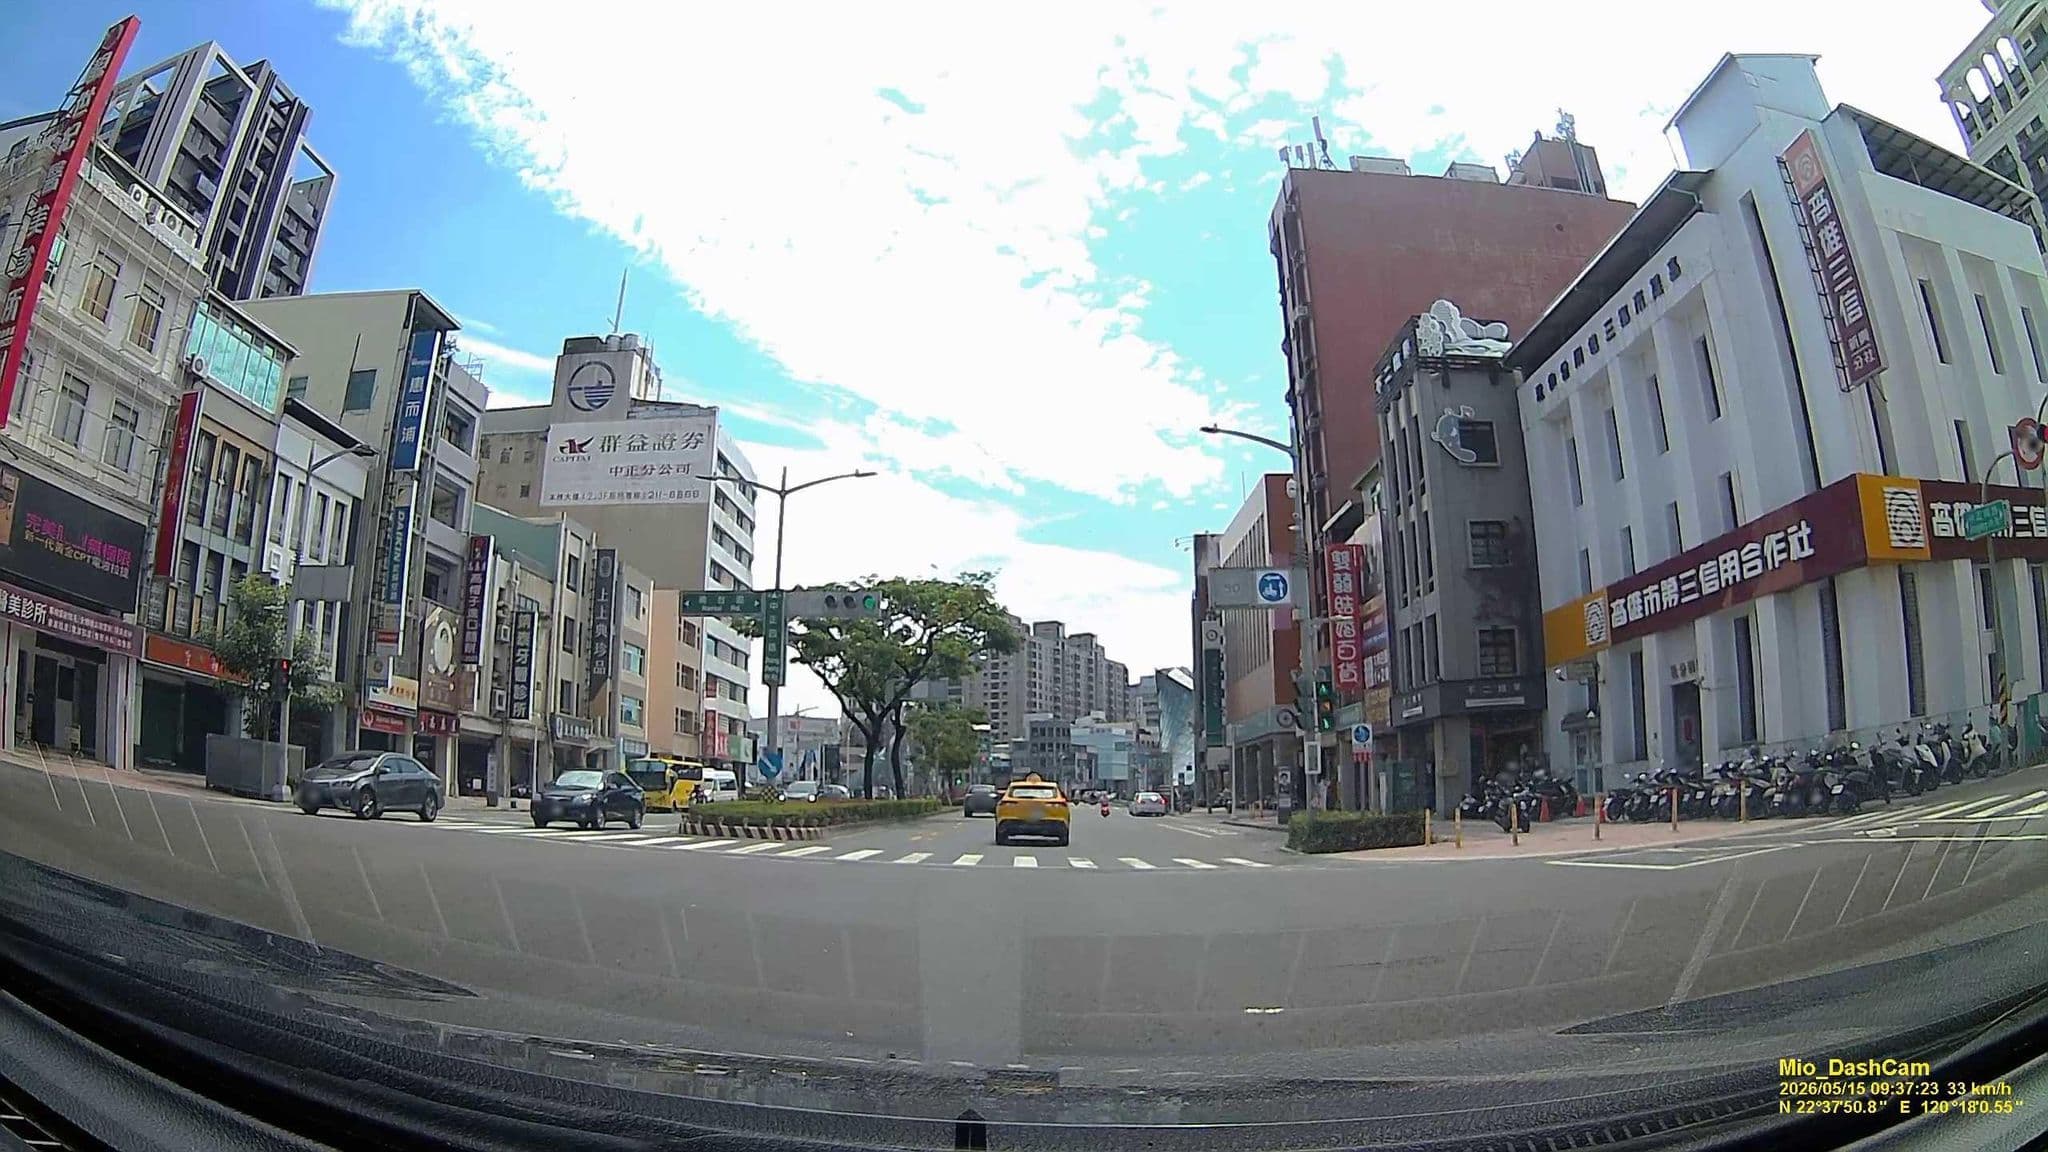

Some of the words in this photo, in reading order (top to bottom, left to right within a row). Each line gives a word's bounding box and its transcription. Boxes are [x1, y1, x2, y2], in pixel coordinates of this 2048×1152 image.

[1807, 187, 1863, 328] 高雄三信
[599, 431, 704, 454] 群益證券
[609, 463, 691, 478] 中正分公司
[393, 510, 405, 561] DAIKIN
[1610, 519, 1815, 628] 高雄市第三信用合作社
[593, 586, 610, 675] 上上典珍品
